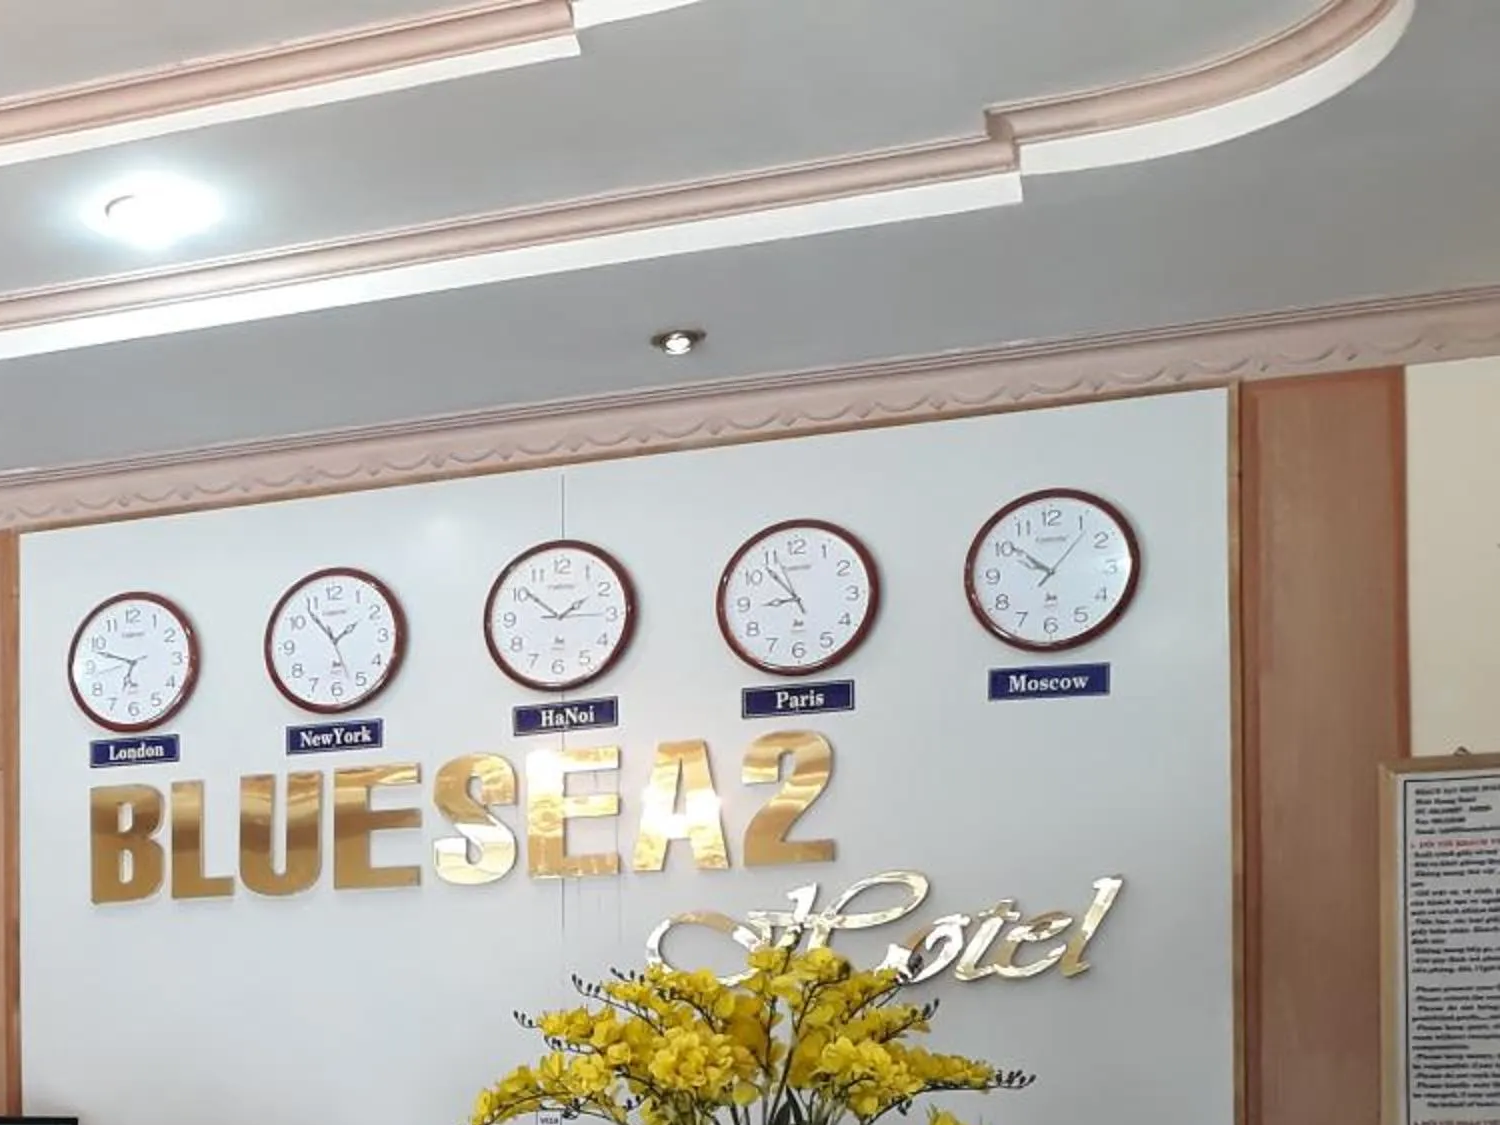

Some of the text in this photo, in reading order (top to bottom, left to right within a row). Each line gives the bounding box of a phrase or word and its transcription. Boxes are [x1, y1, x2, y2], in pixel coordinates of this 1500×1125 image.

[1042, 510, 1062, 526] 12
[1078, 516, 1083, 530] 1
[1016, 520, 1031, 537] 11
[787, 539, 806, 555] 12
[1094, 532, 1108, 549] 2
[822, 544, 827, 558] 1
[995, 541, 1013, 556] 10
[764, 550, 778, 565] 11
[554, 559, 571, 574] 12
[585, 565, 590, 579] 1
[837, 560, 850, 577] 2
[1105, 559, 1118, 574] 3
[531, 568, 544, 582] 11
[745, 569, 763, 585] 10
[985, 568, 1000, 585] 9
[326, 585, 343, 600] 12
[356, 590, 360, 603] 1
[513, 587, 529, 602] 10
[598, 582, 611, 597] 2
[846, 585, 859, 600] 3
[1095, 587, 1107, 601] 4
[307, 596, 318, 610] 11
[737, 597, 750, 613] 9
[995, 594, 1010, 610] 8
[125, 608, 141, 623] 12
[369, 604, 381, 620] 2
[605, 607, 618, 622] 3
[838, 613, 851, 625] 4
[1016, 612, 1028, 627] 7
[1074, 606, 1088, 623] 5
[106, 619, 117, 632] 11
[152, 614, 157, 628] 1
[290, 615, 306, 630] 10
[504, 612, 517, 628] 9
[1044, 618, 1058, 634] 6
[164, 628, 176, 643] 2
[378, 628, 389, 642] 3
[746, 622, 760, 637] 8
[92, 636, 106, 650] 10
[510, 637, 523, 652] 8
[596, 632, 608, 646] 4
[766, 638, 778, 652] 7
[820, 632, 834, 648] 5
[283, 640, 294, 655] 9
[792, 642, 806, 658] 6
[172, 652, 182, 665] 3
[372, 654, 381, 665] 4
[528, 654, 539, 668] 7
[579, 650, 591, 666] 5
[86, 660, 96, 674] 9
[292, 664, 302, 678] 8
[552, 660, 564, 674] 6
[165, 675, 175, 688] 4
[309, 678, 319, 692] 7
[355, 672, 367, 687] 5
[1008, 674, 1089, 693] Moscow
[92, 682, 103, 696] 8
[331, 682, 343, 696] 6
[108, 698, 117, 710] 7
[151, 692, 162, 706] 5
[775, 689, 825, 709] Paris
[128, 702, 140, 716] 6
[541, 705, 595, 727] HaNoi
[300, 726, 372, 748] NewYork
[109, 741, 165, 761] London
[644, 869, 1124, 985] Hotel
